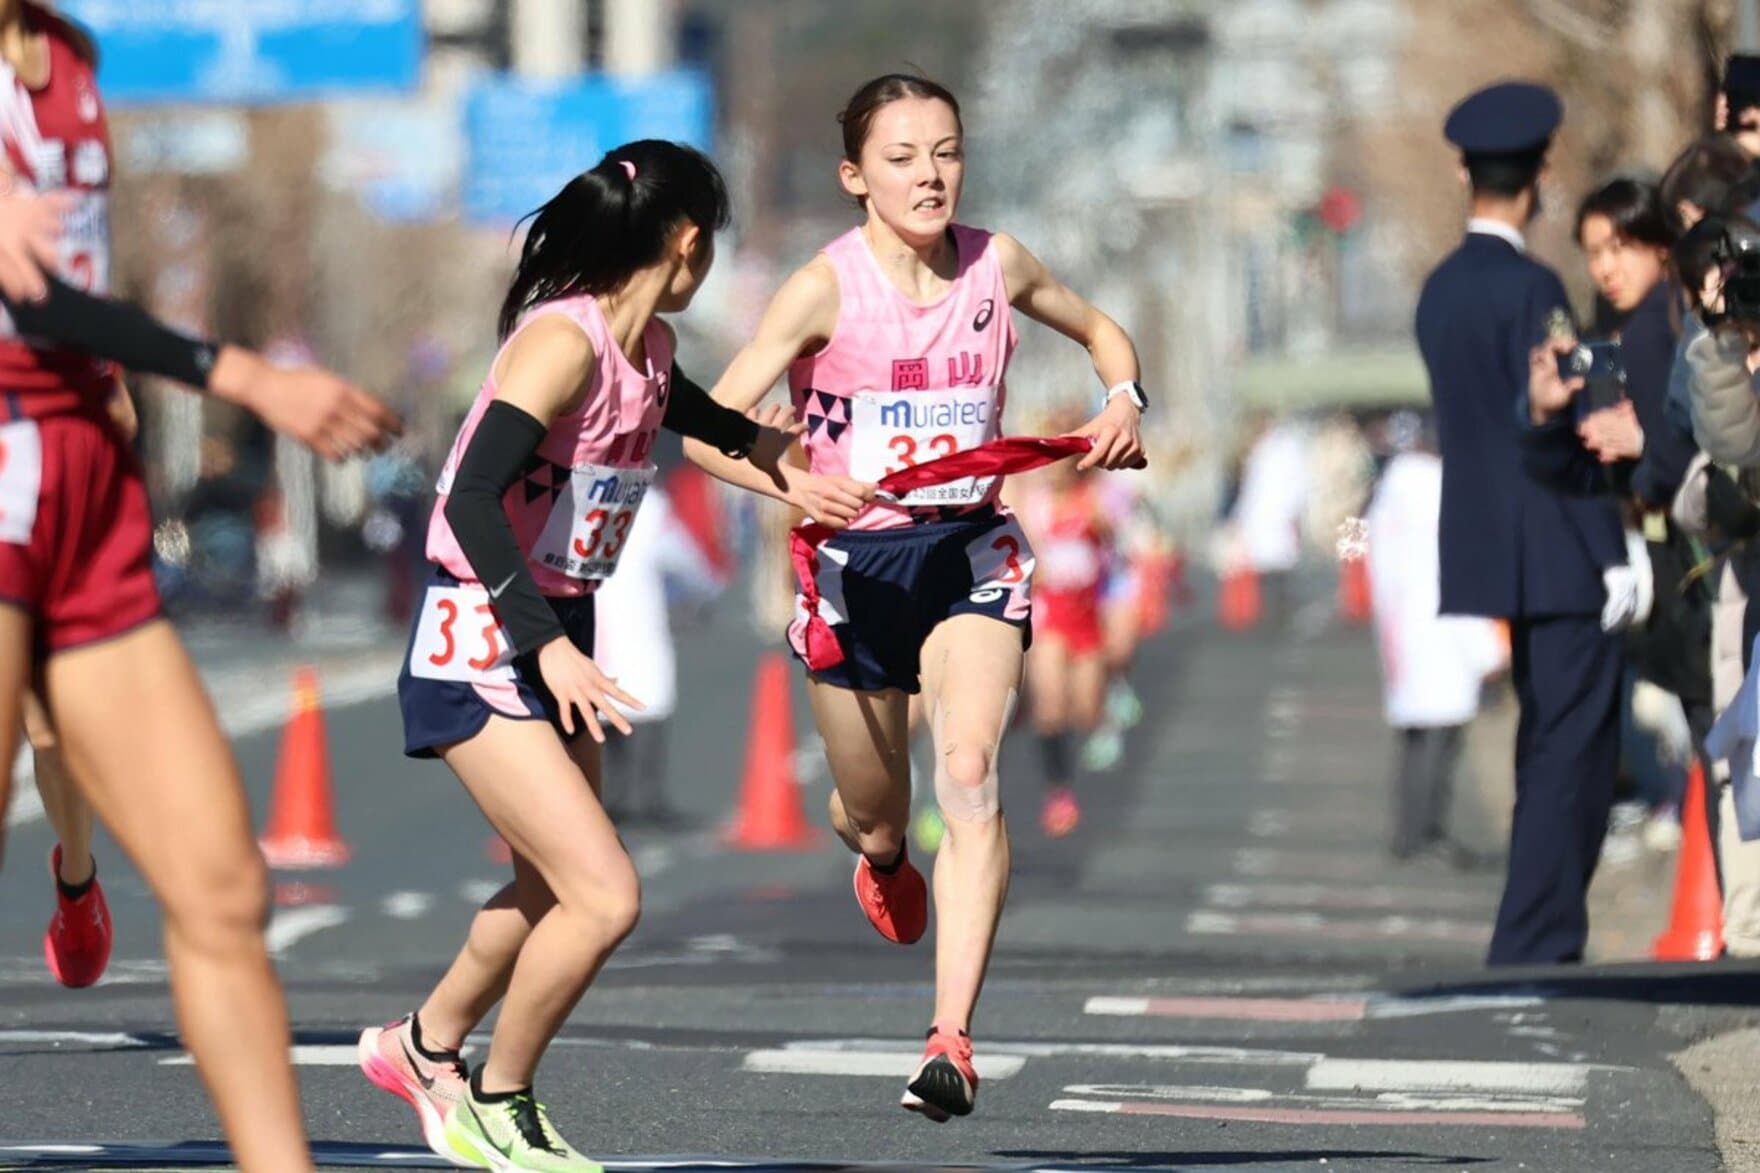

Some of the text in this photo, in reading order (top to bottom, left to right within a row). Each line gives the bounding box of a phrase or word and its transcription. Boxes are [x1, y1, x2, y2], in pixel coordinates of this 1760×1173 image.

[891, 351, 983, 392] 岡山
[574, 508, 632, 559] 33
[429, 598, 503, 671] 33
